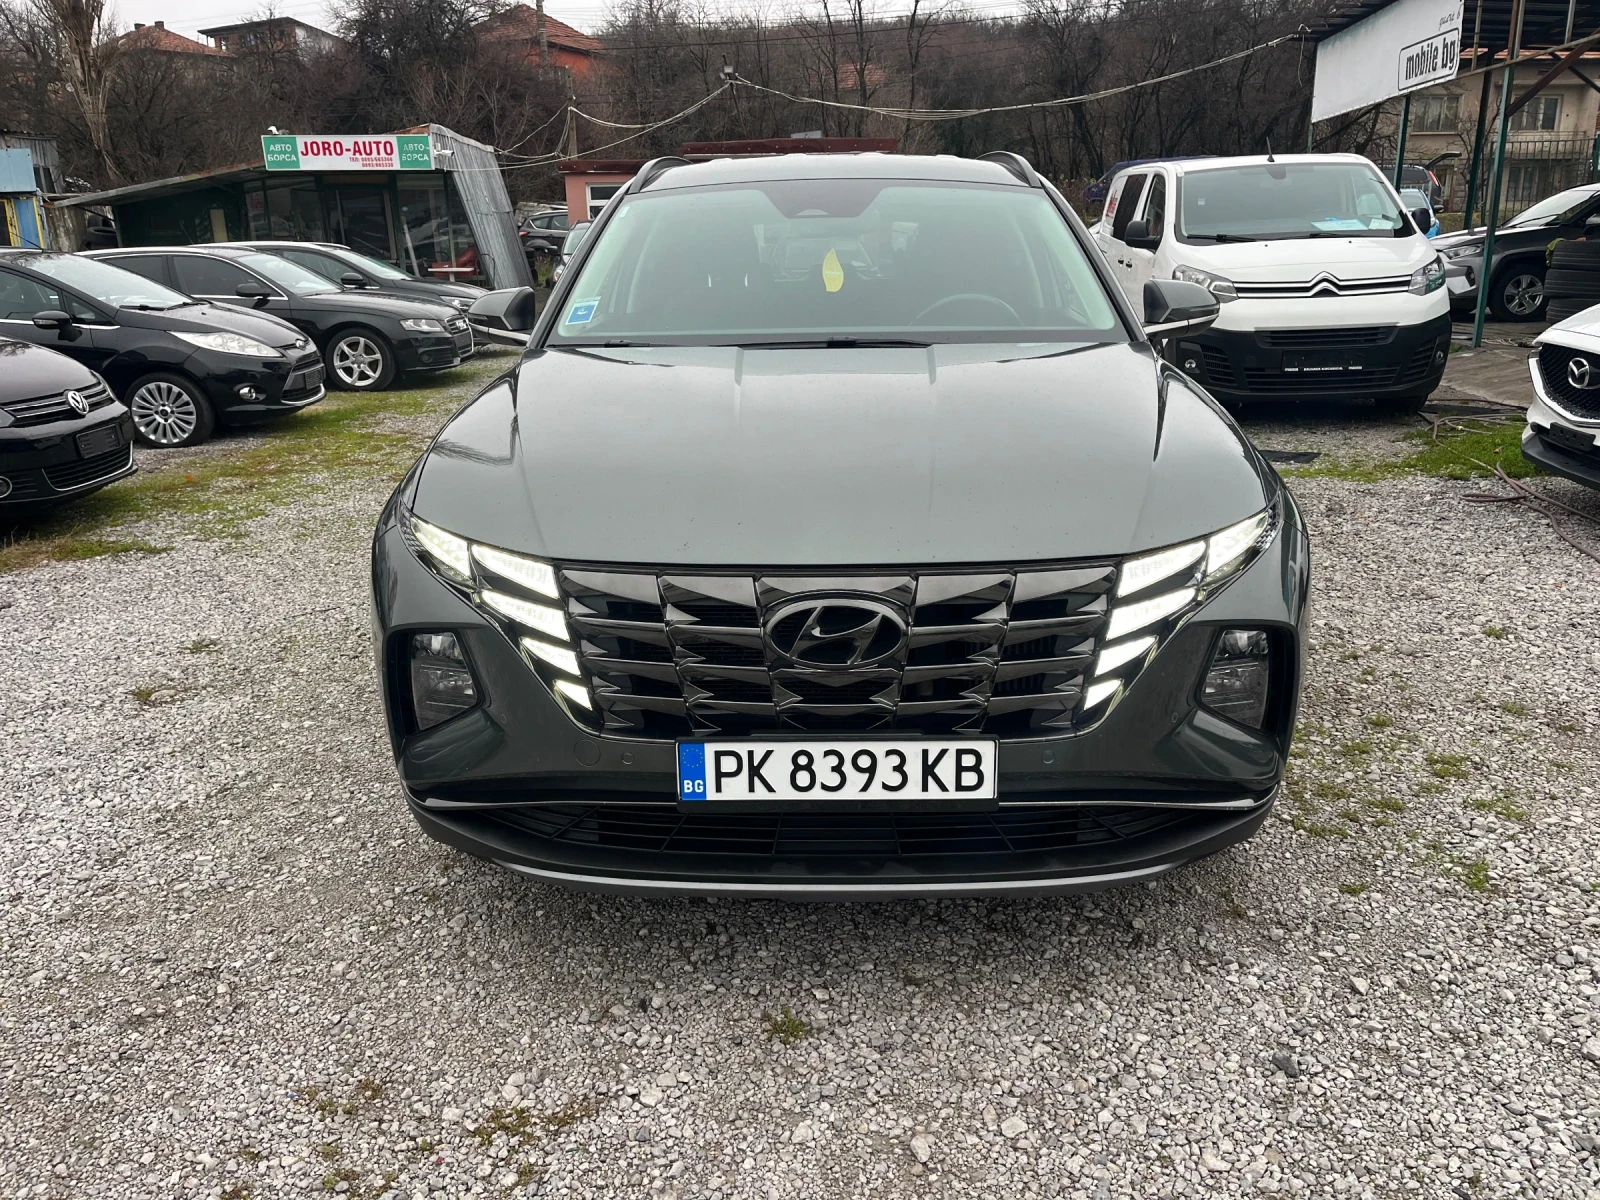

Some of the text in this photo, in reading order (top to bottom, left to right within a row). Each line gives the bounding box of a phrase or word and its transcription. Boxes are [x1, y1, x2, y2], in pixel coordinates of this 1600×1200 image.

[1405, 37, 1457, 80] mobile bg
[269, 143, 292, 152] АВТО
[301, 140, 394, 157] JORO-AUTO
[267, 153, 297, 162] БОРСА
[401, 153, 429, 162] БОРСА
[714, 748, 985, 793] PK 8393 KB
[683, 780, 704, 793] BG
